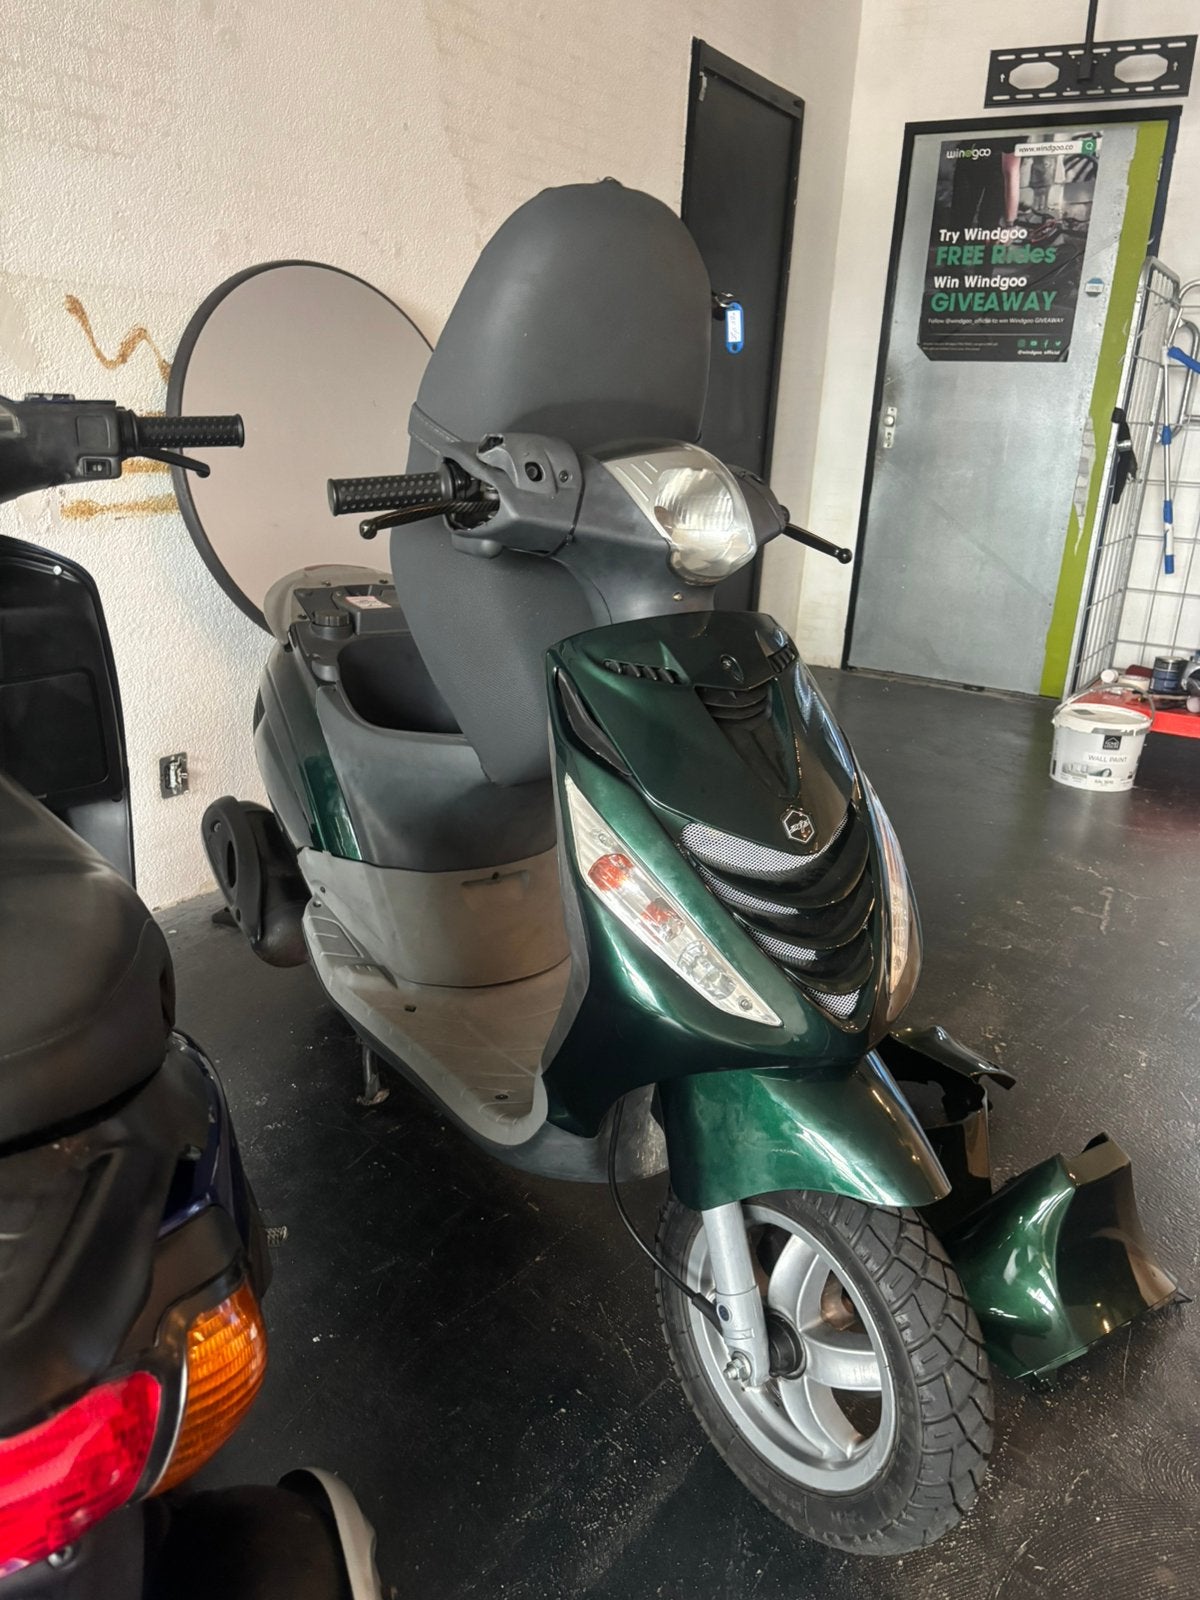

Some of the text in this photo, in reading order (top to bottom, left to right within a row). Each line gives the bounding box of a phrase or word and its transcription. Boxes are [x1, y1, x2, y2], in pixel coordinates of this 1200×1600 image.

[939, 228, 1028, 244] Try Windgoo
[936, 244, 1057, 266] FREE Rides
[934, 275, 1028, 291] Win Windgoo
[930, 291, 1057, 312] GIVEAWAY
[1088, 754, 1107, 763] WALL
